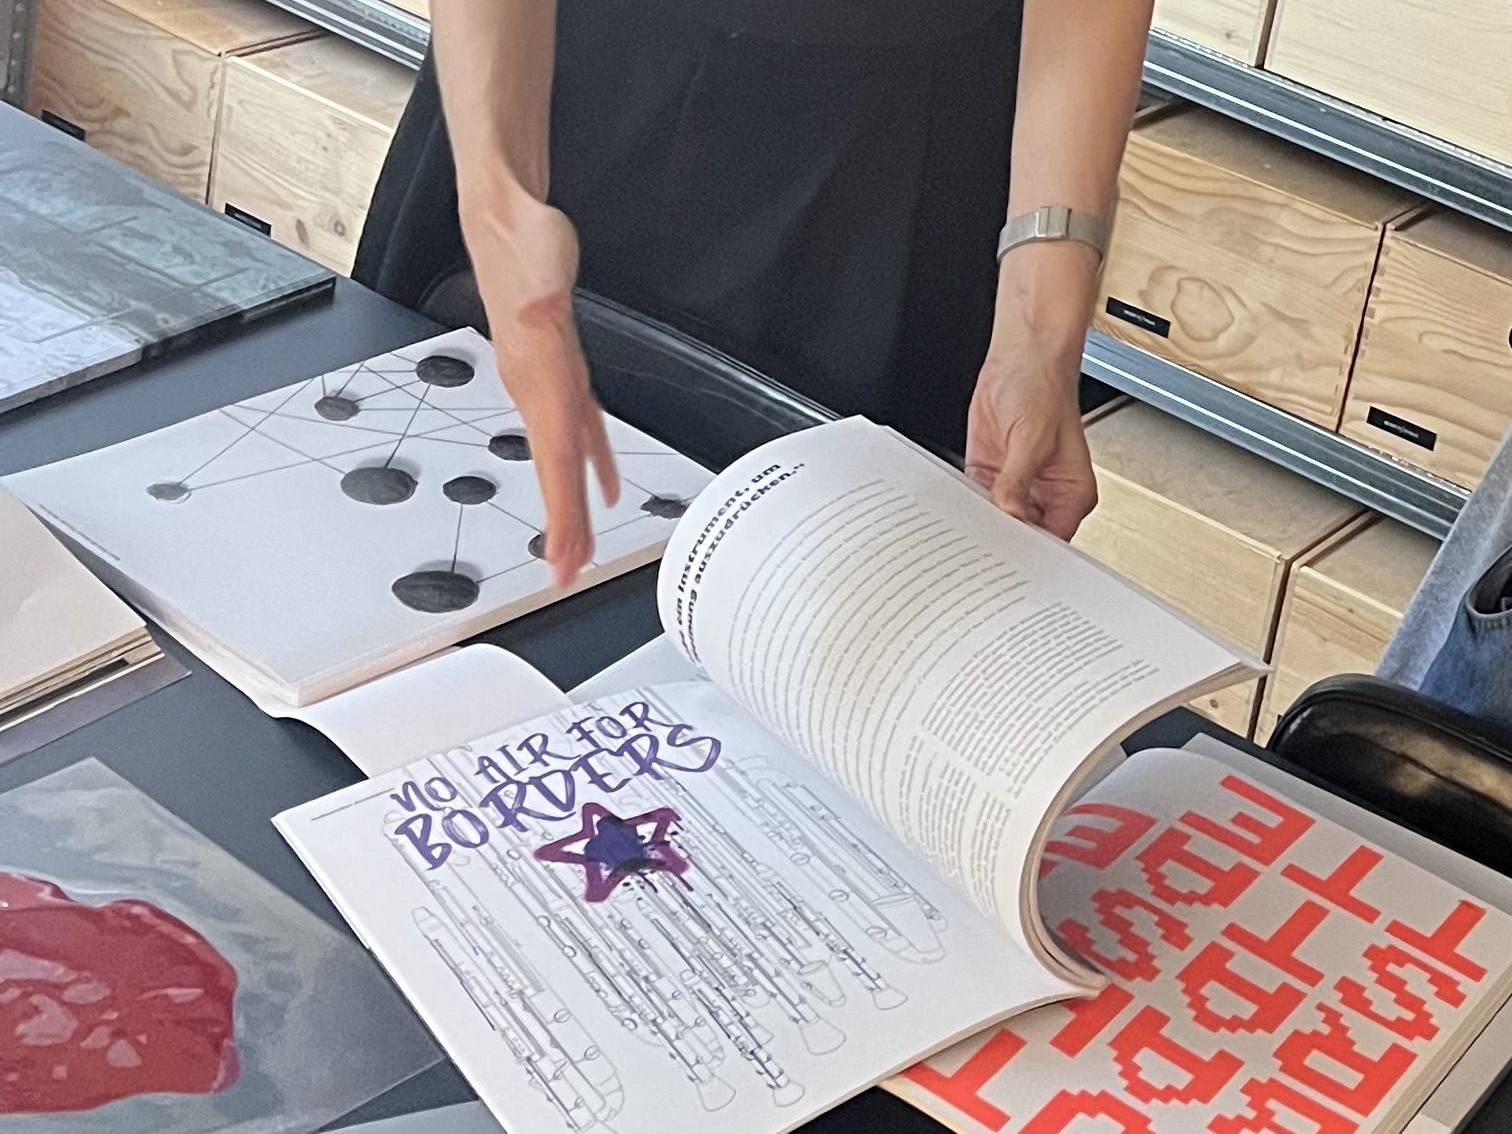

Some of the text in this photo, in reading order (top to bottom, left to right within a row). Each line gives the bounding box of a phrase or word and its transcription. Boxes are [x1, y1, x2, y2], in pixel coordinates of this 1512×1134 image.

[751, 464, 780, 483] um
[475, 732, 581, 785] AIR
[566, 701, 680, 749] FOR
[395, 723, 721, 871] BORDERS
